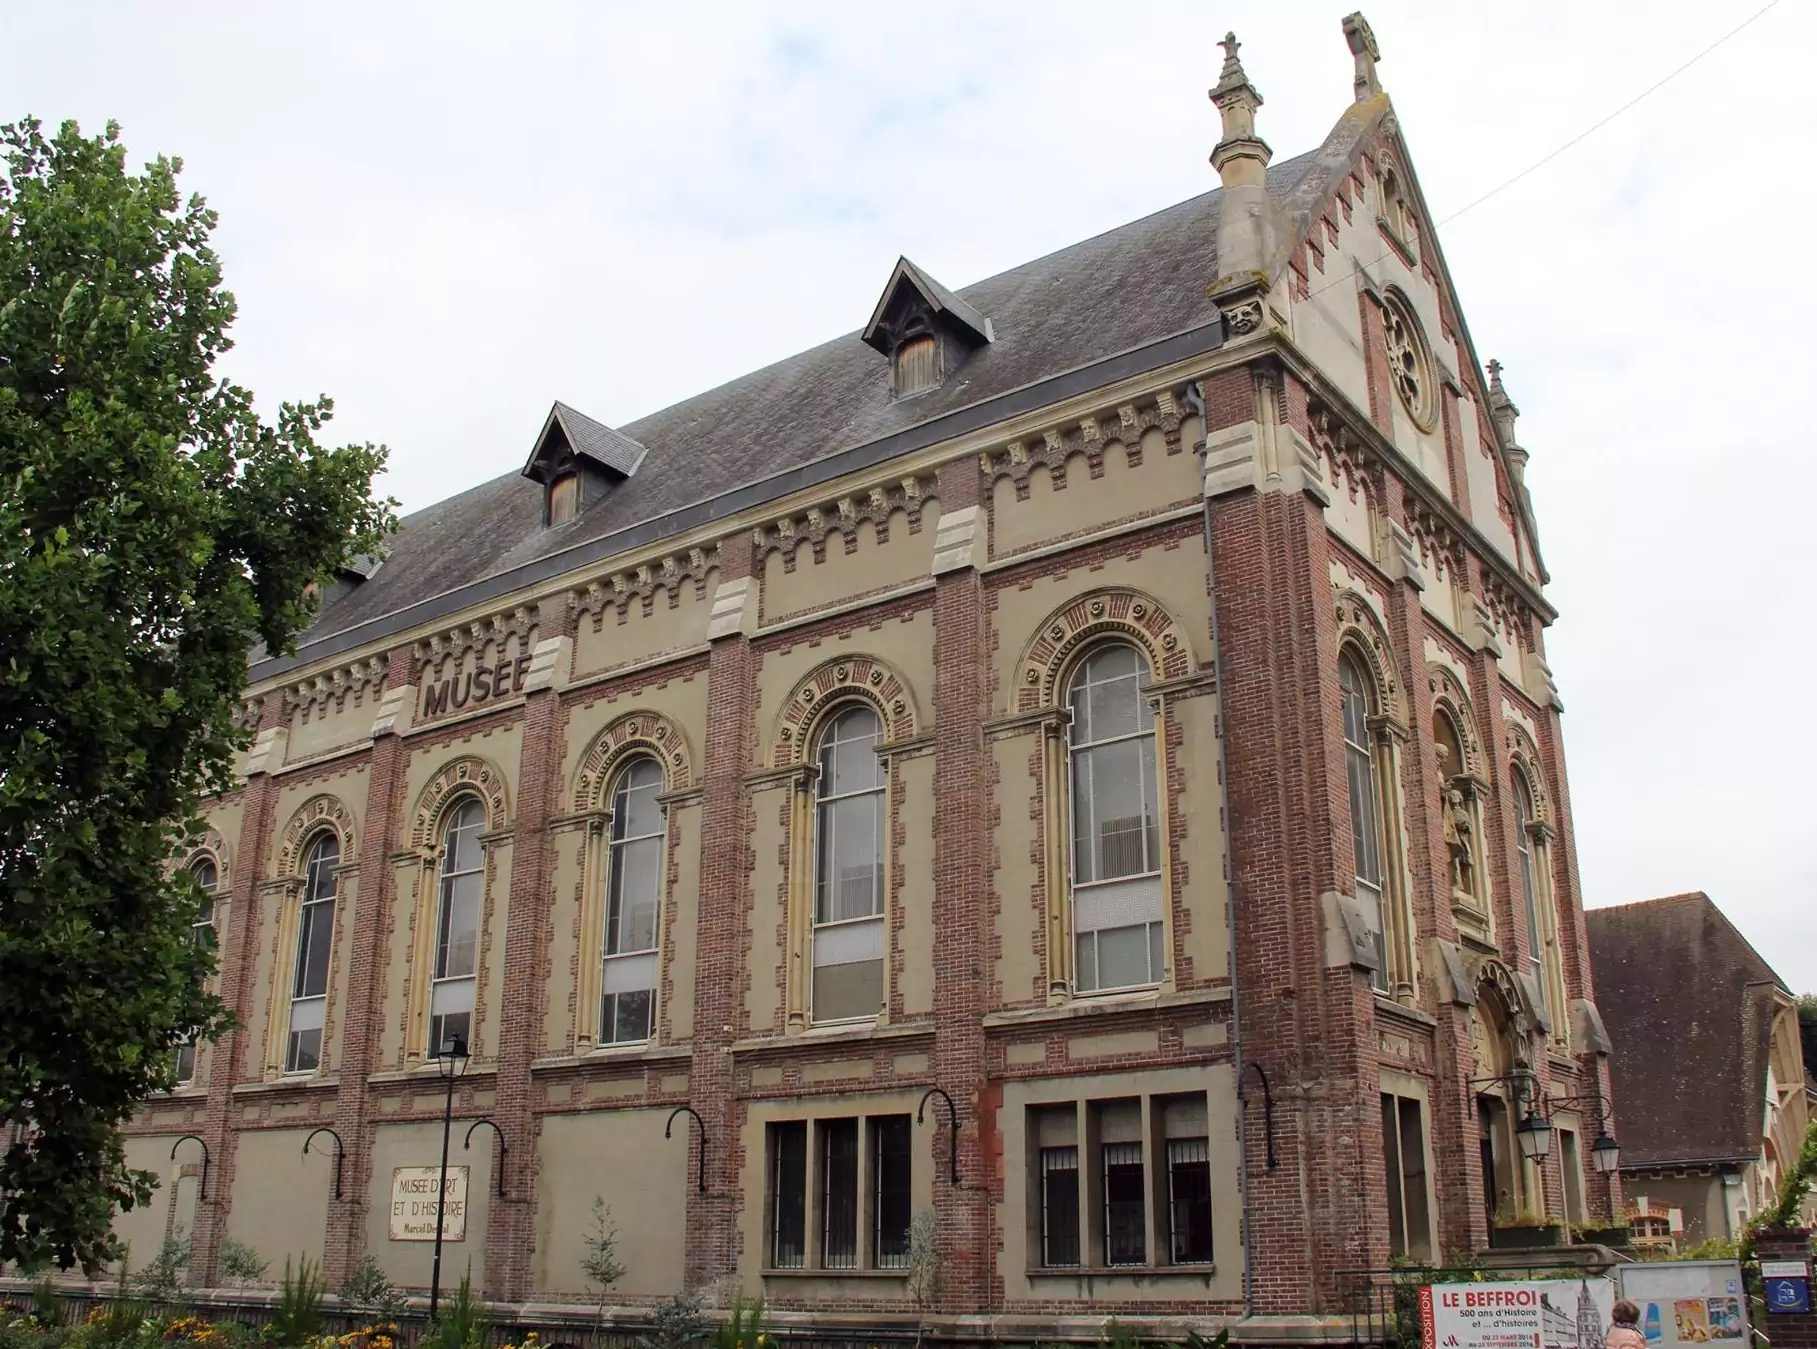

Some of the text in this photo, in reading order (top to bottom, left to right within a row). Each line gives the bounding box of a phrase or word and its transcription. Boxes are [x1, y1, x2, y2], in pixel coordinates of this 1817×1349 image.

[423, 653, 533, 718] MUSEE
[399, 1178, 458, 1195] MUSEE D'RT
[393, 1200, 463, 1218] ET D'HISOIRE
[1442, 1290, 1537, 1308] LE BEFFROI
[1421, 1291, 1433, 1349] XPOSITION
[1459, 1308, 1538, 1318] 500 ans d'Histoire
[1471, 1320, 1481, 1328] et
[1493, 1319, 1539, 1328] d'histoires
